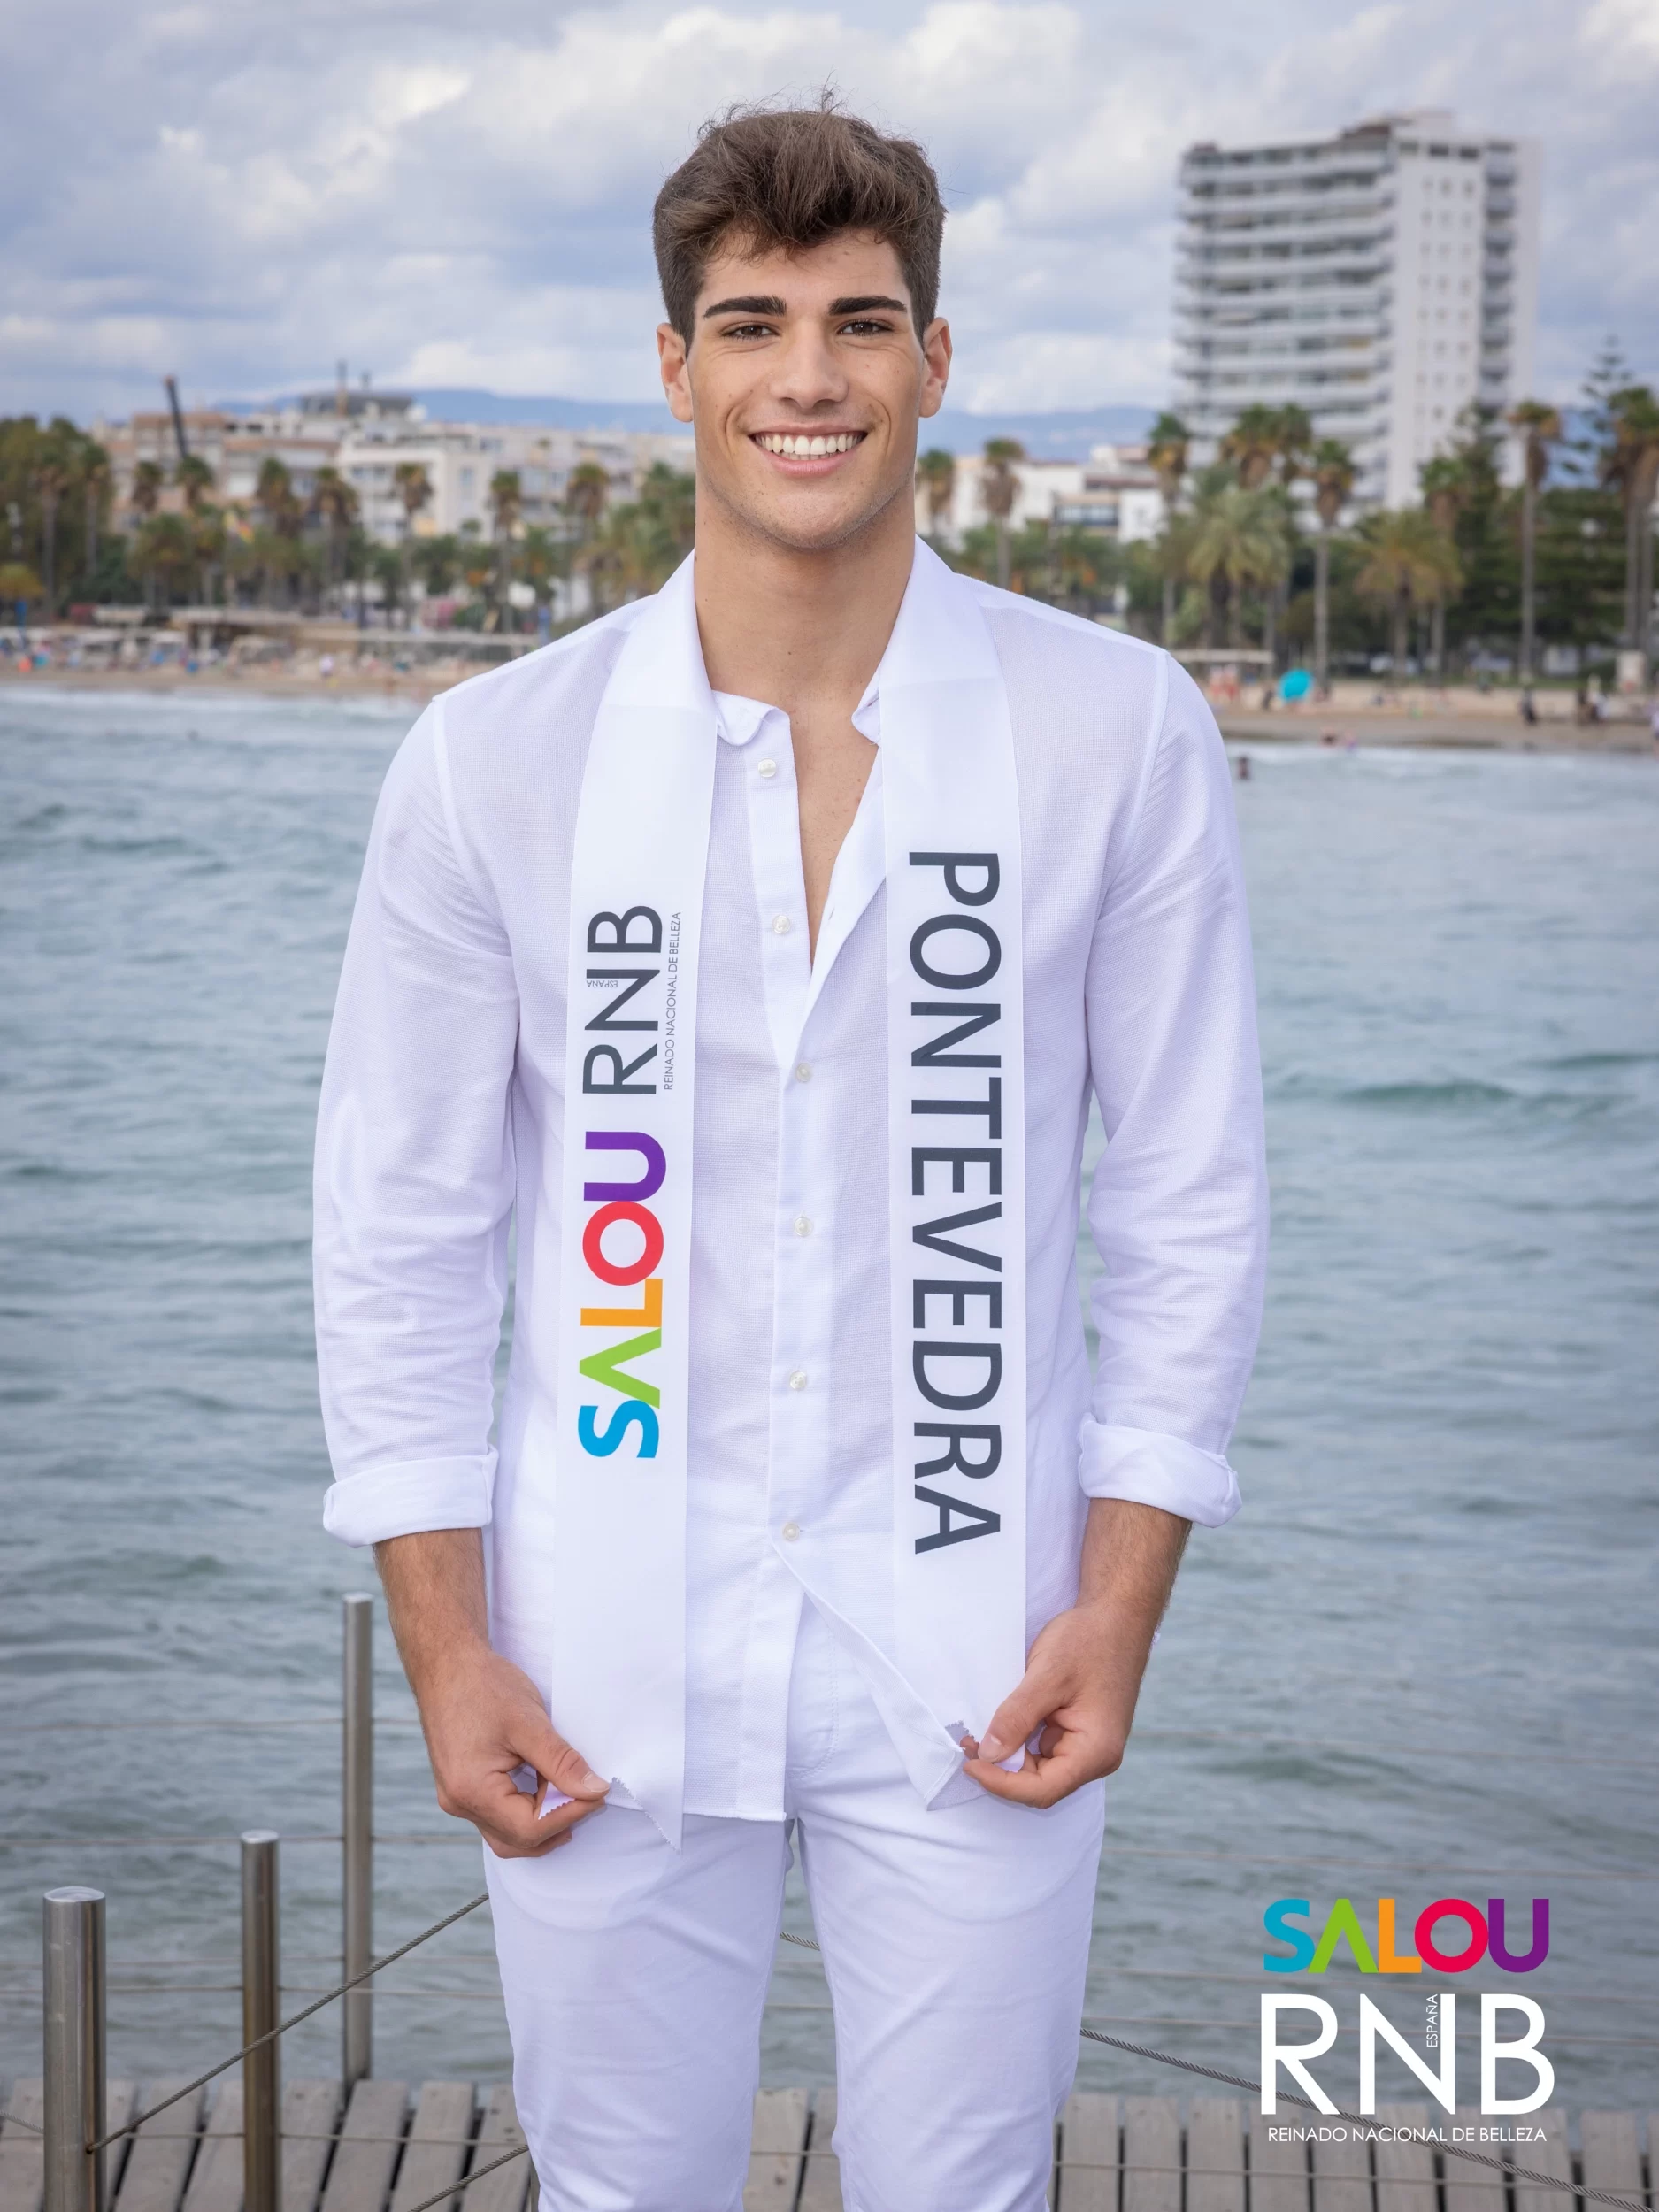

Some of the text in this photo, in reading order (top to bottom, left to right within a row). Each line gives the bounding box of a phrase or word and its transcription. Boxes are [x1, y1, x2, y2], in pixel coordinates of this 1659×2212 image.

[582, 905, 663, 1094] RNB
[586, 979, 618, 988] ESPAÑA
[664, 911, 681, 1090] REINADO NACIONAL DE BELLEZA
[578, 1131, 666, 1460] SALOU
[908, 850, 1002, 1555] PONTEVEDRA
